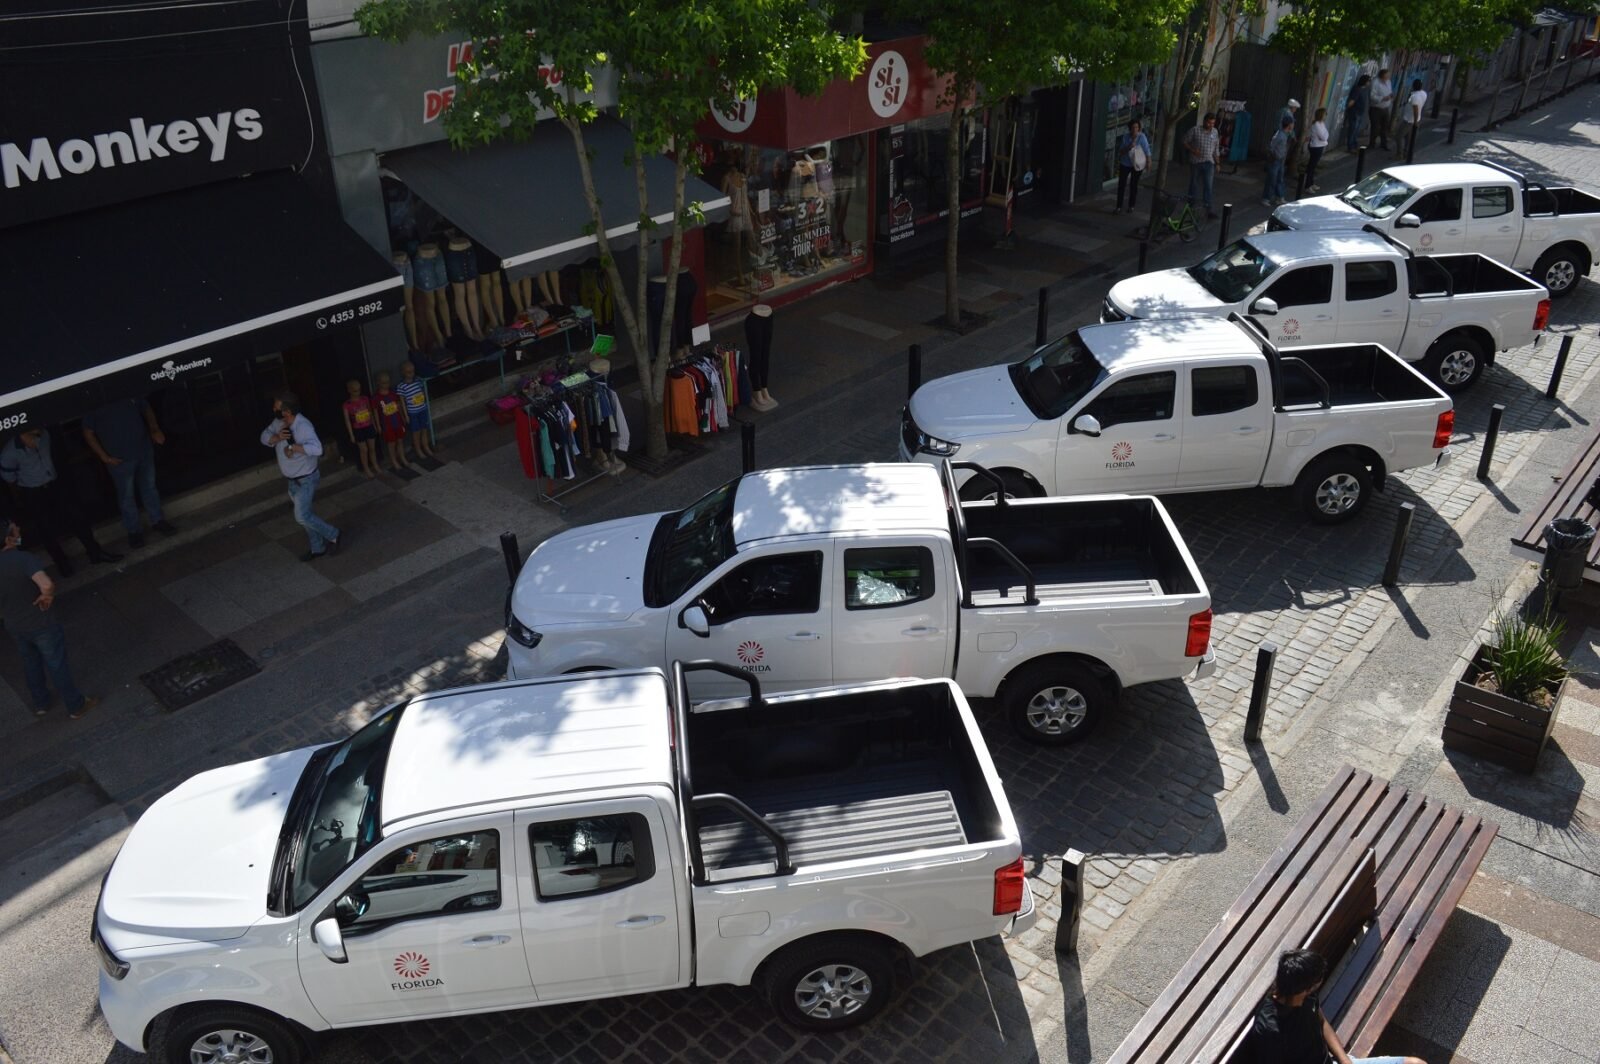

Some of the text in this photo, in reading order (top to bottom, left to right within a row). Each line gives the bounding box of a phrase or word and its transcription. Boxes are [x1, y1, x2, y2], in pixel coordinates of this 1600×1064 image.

[875, 58, 894, 88] si
[882, 77, 901, 107] si
[0, 107, 263, 189] Monkeys
[793, 225, 831, 245] SUMMER
[330, 300, 383, 325] 4353 3892
[150, 357, 212, 381] Old Monkeys
[1105, 461, 1135, 469] FLORIDA
[391, 978, 444, 990] FLORIDA
